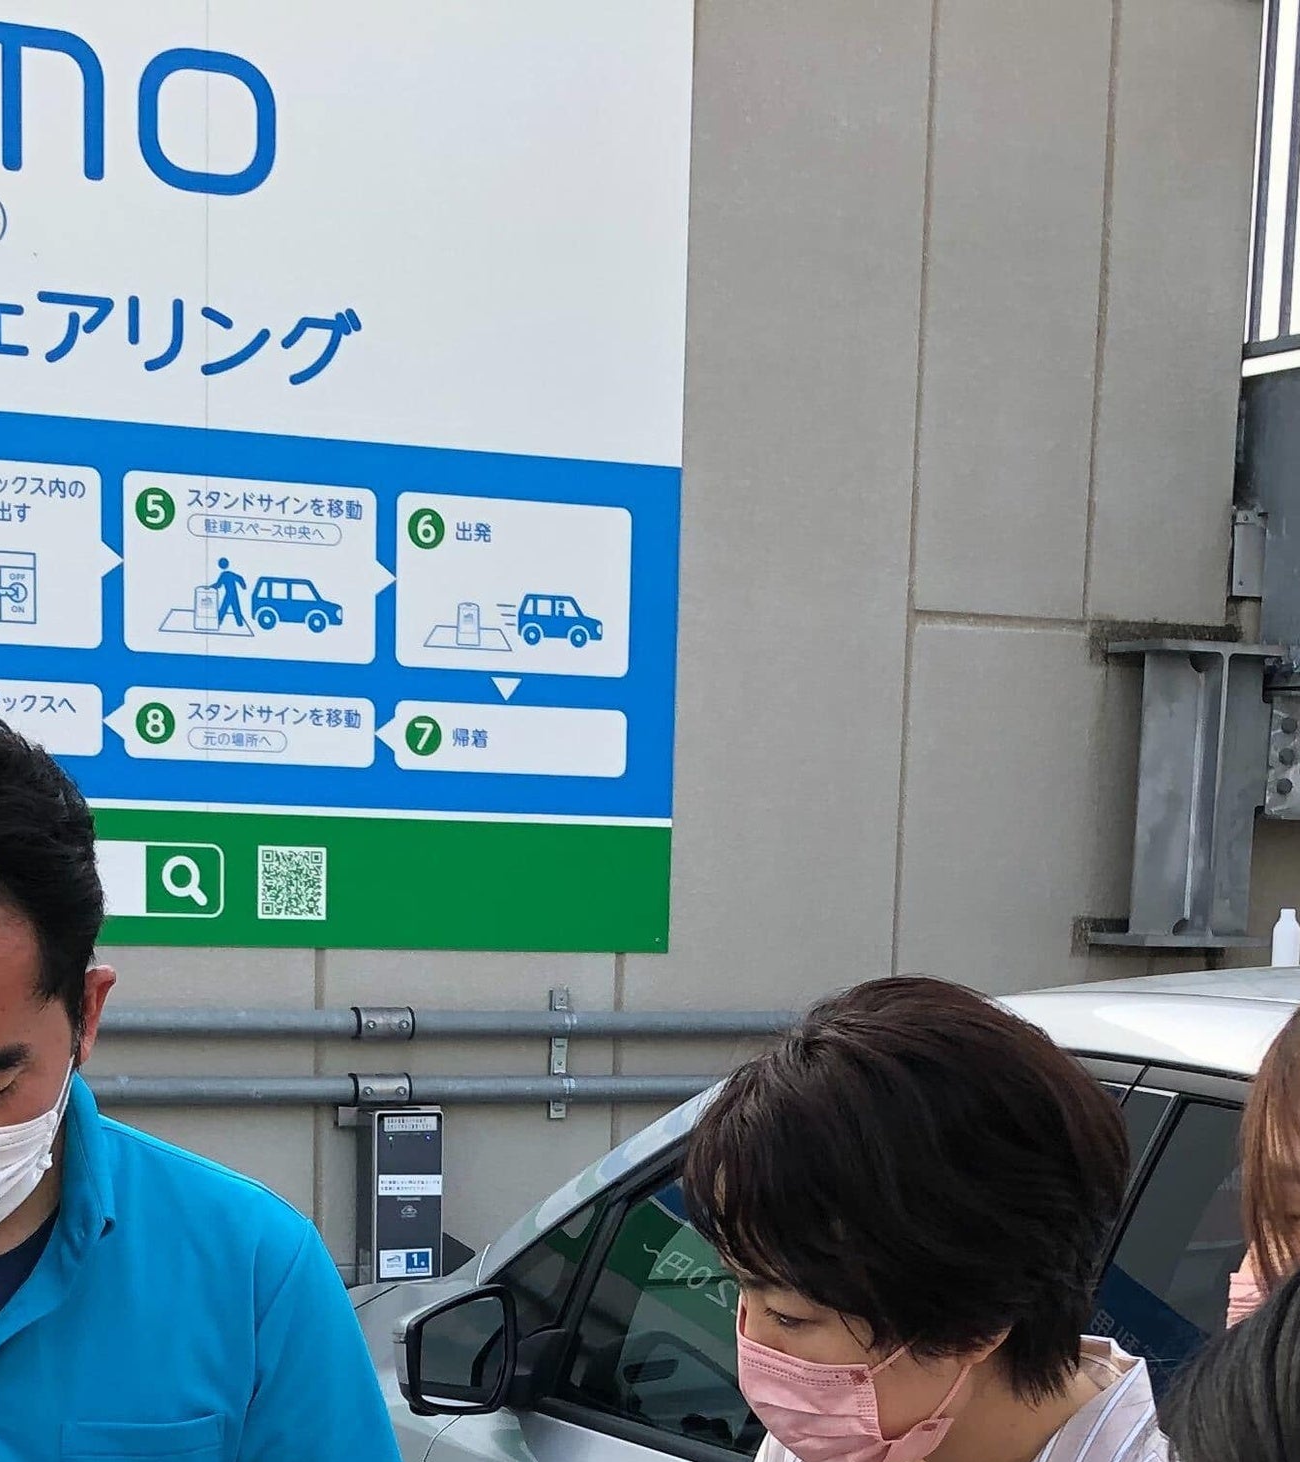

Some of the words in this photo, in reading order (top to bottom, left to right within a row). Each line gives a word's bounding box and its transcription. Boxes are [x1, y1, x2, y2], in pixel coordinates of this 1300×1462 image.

[145, 494, 166, 525] 5
[187, 488, 363, 521] スタンドサインを移動
[416, 514, 438, 544] 6
[455, 522, 491, 543] 出発
[145, 708, 166, 738] 8
[187, 702, 361, 729] スタンドサインを移動
[203, 731, 272, 749] 元の場所へ
[414, 722, 433, 750] 7
[452, 728, 489, 749] 帰着
